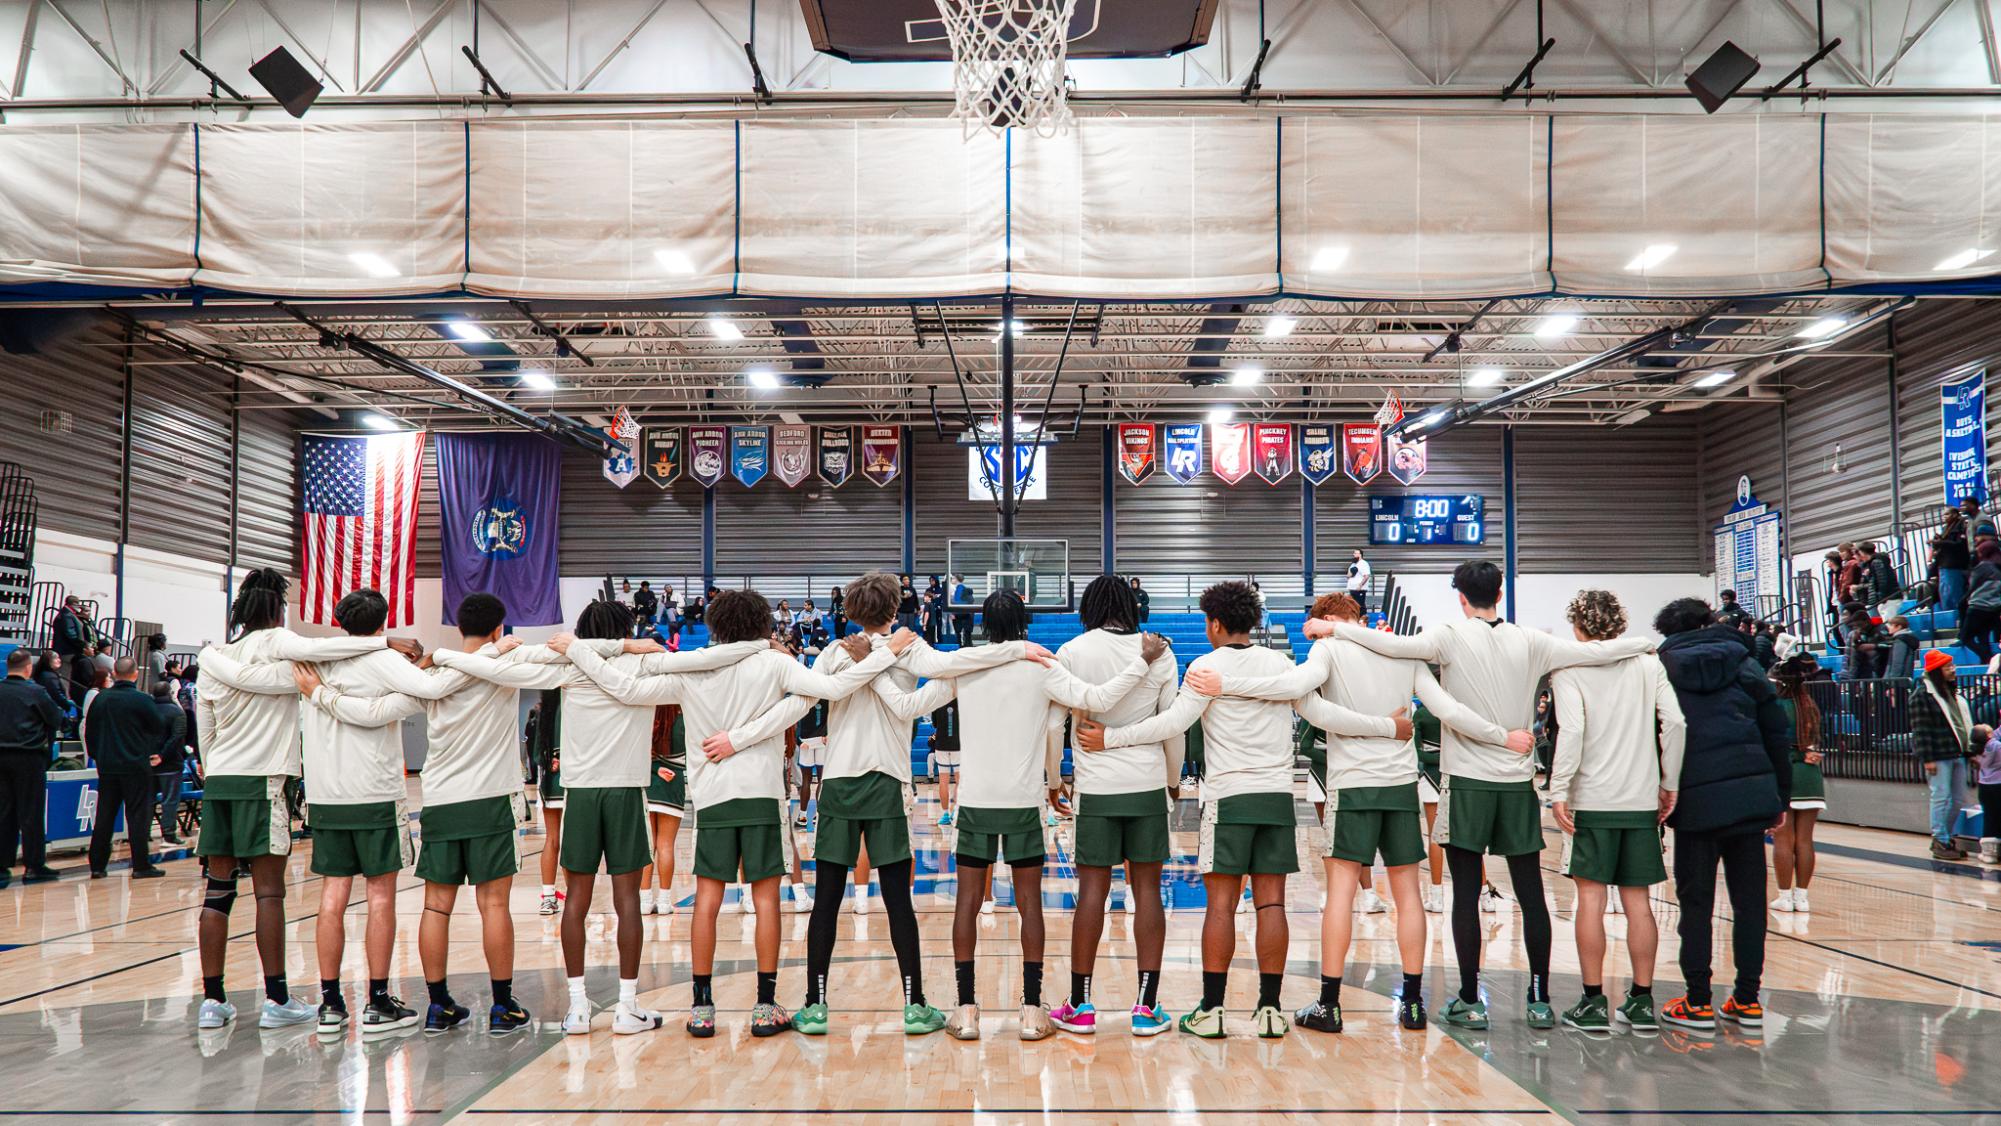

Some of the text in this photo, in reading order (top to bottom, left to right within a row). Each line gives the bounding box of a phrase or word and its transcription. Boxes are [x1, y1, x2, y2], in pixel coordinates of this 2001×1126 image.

[1124, 428, 1149, 436] JACKSON
[1125, 437, 1148, 445] VIKINGS
[1414, 499, 1450, 518] 8:00
[1388, 522, 1401, 541] 0
[1426, 527, 1432, 540] 1
[1467, 522, 1480, 541] 0
